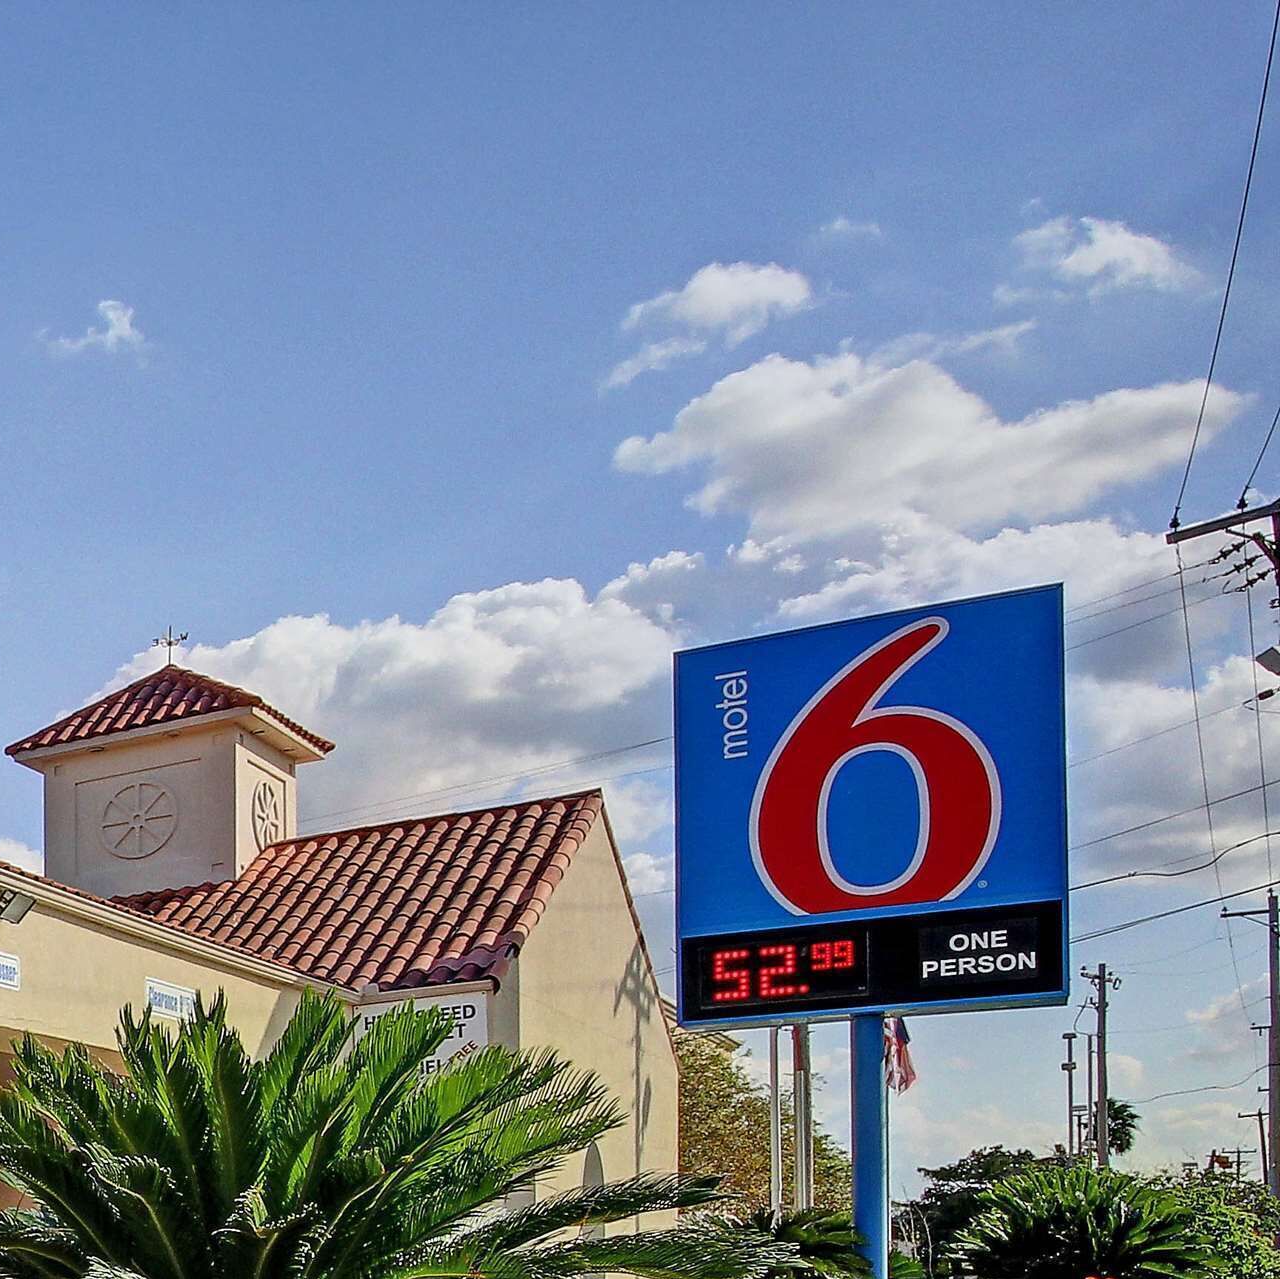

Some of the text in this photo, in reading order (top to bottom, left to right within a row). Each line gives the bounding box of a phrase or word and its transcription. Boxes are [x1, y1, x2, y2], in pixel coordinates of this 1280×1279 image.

[715, 671, 748, 759] motel
[749, 616, 1002, 916] 6
[922, 952, 1037, 979] PERSON
[949, 930, 1008, 952] ONE
